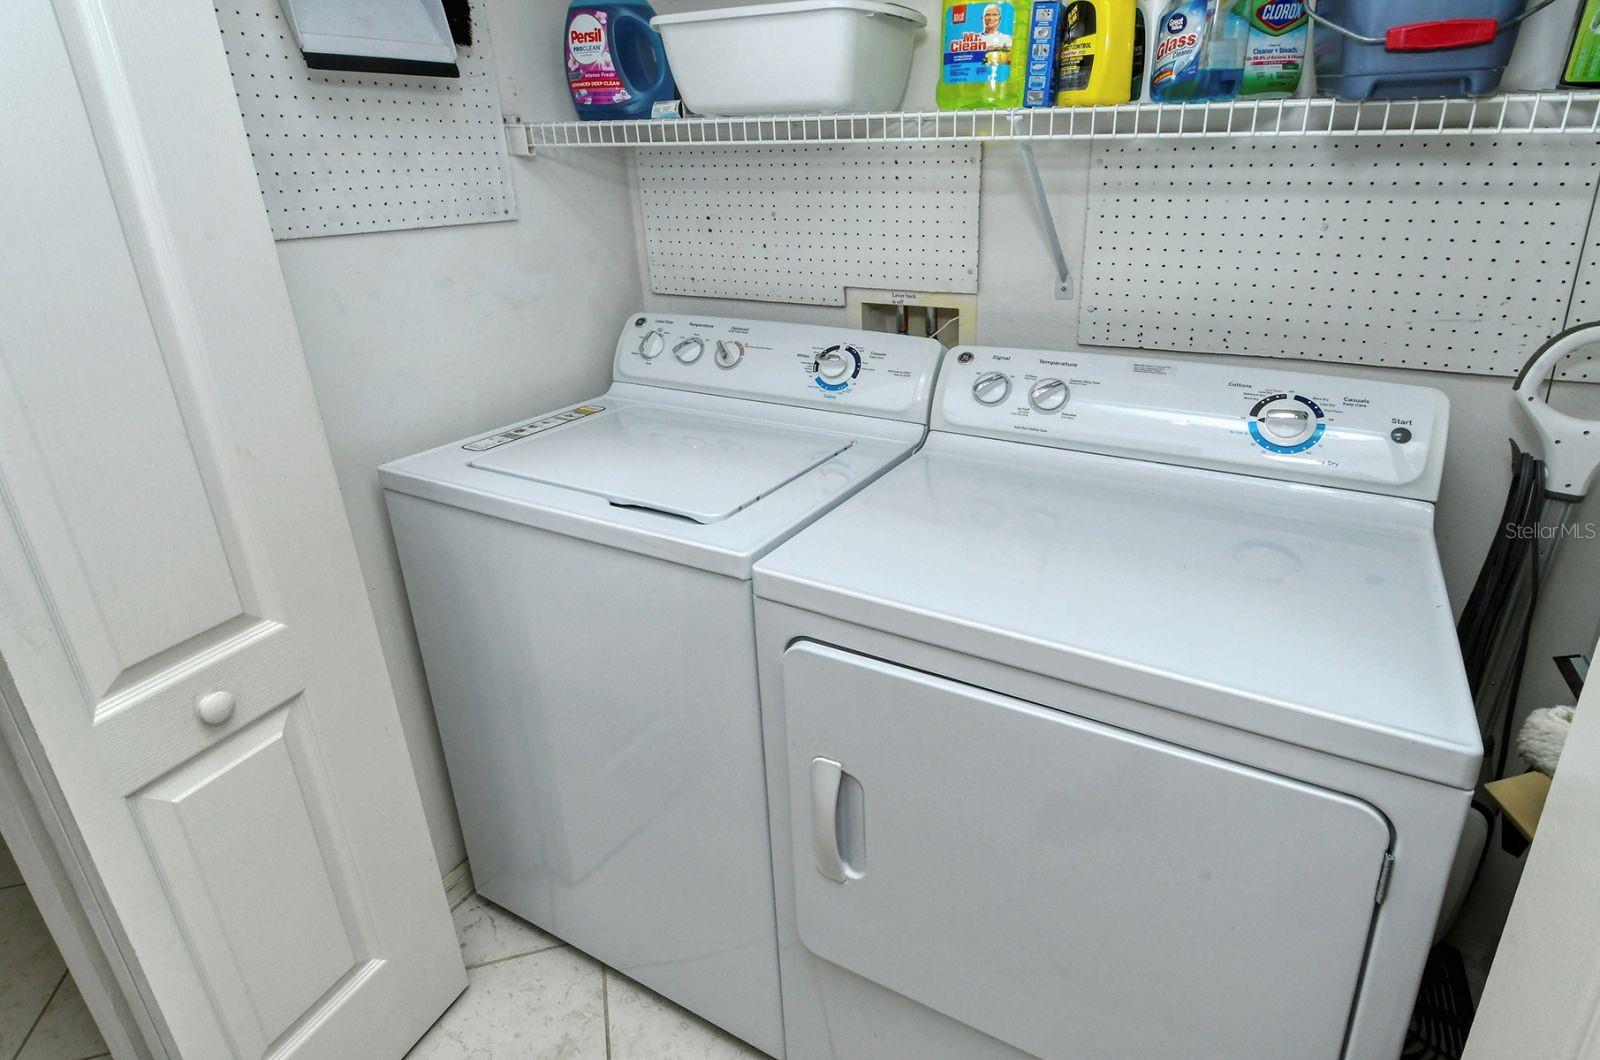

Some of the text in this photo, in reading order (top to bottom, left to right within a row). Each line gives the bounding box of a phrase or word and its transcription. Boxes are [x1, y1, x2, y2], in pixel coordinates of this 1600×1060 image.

[1262, 3, 1304, 20] CLOROX
[1168, 17, 1184, 26] Great
[571, 28, 601, 44] Persil
[962, 33, 982, 42] Mr.
[951, 41, 987, 52] Clean
[1156, 33, 1197, 60] Glass
[1173, 49, 1193, 59] Cleaner
[1039, 359, 1078, 368] Temperature
[1343, 396, 1370, 404] Casuals
